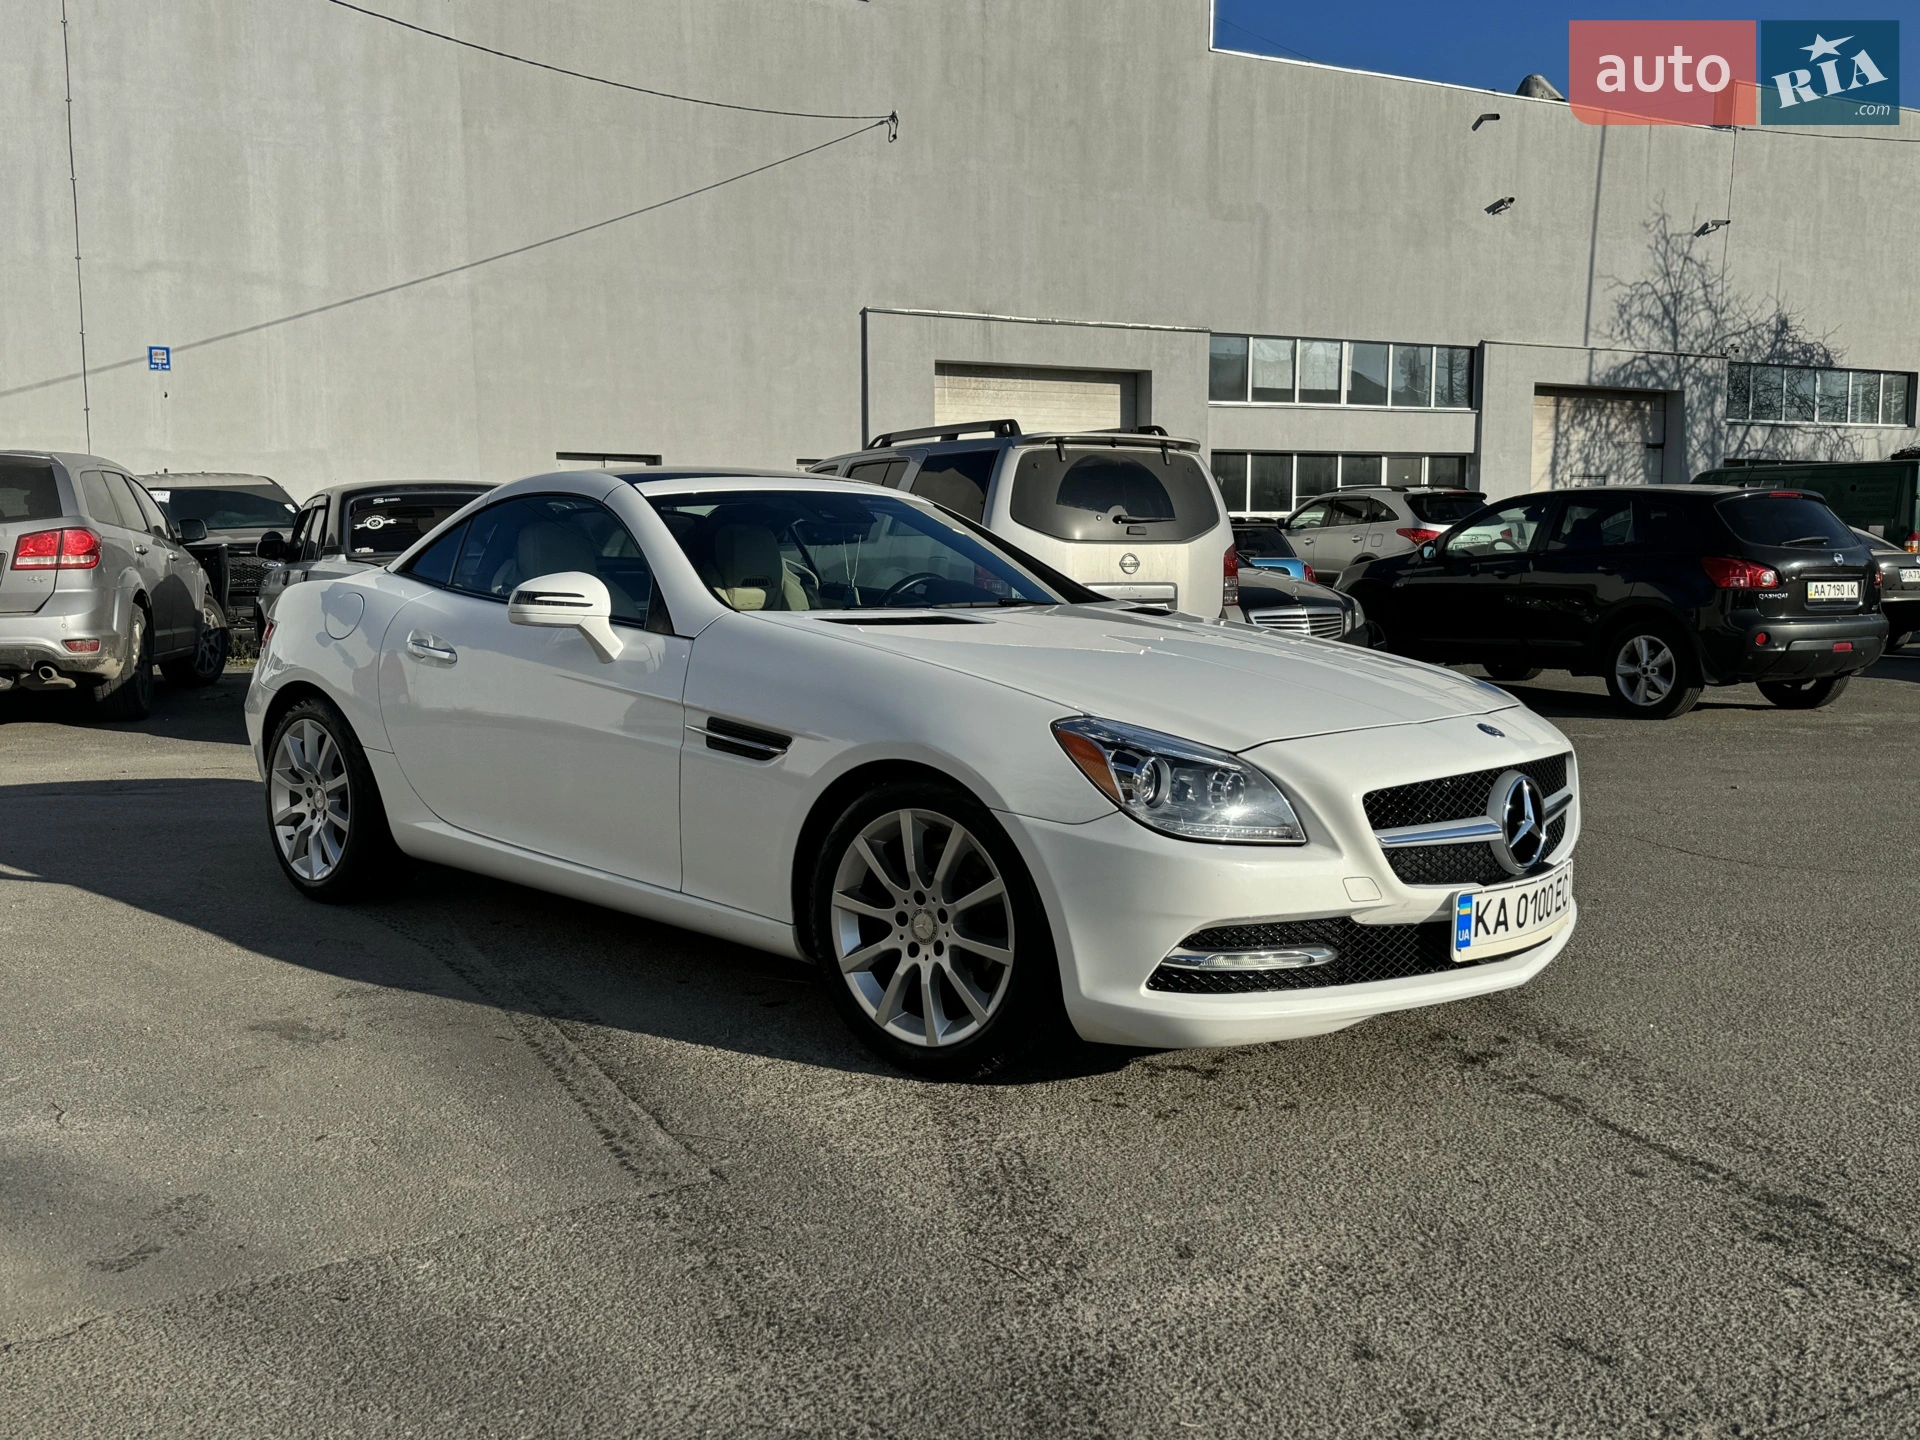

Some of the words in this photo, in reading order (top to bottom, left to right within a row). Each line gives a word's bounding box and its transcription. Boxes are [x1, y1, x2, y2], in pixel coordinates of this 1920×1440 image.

[1847, 584, 1857, 597] IK
[1474, 898, 1509, 938] KA
[1516, 885, 1553, 928] 0100
[1554, 874, 1568, 912] EC
[1458, 929, 1470, 941] UA
